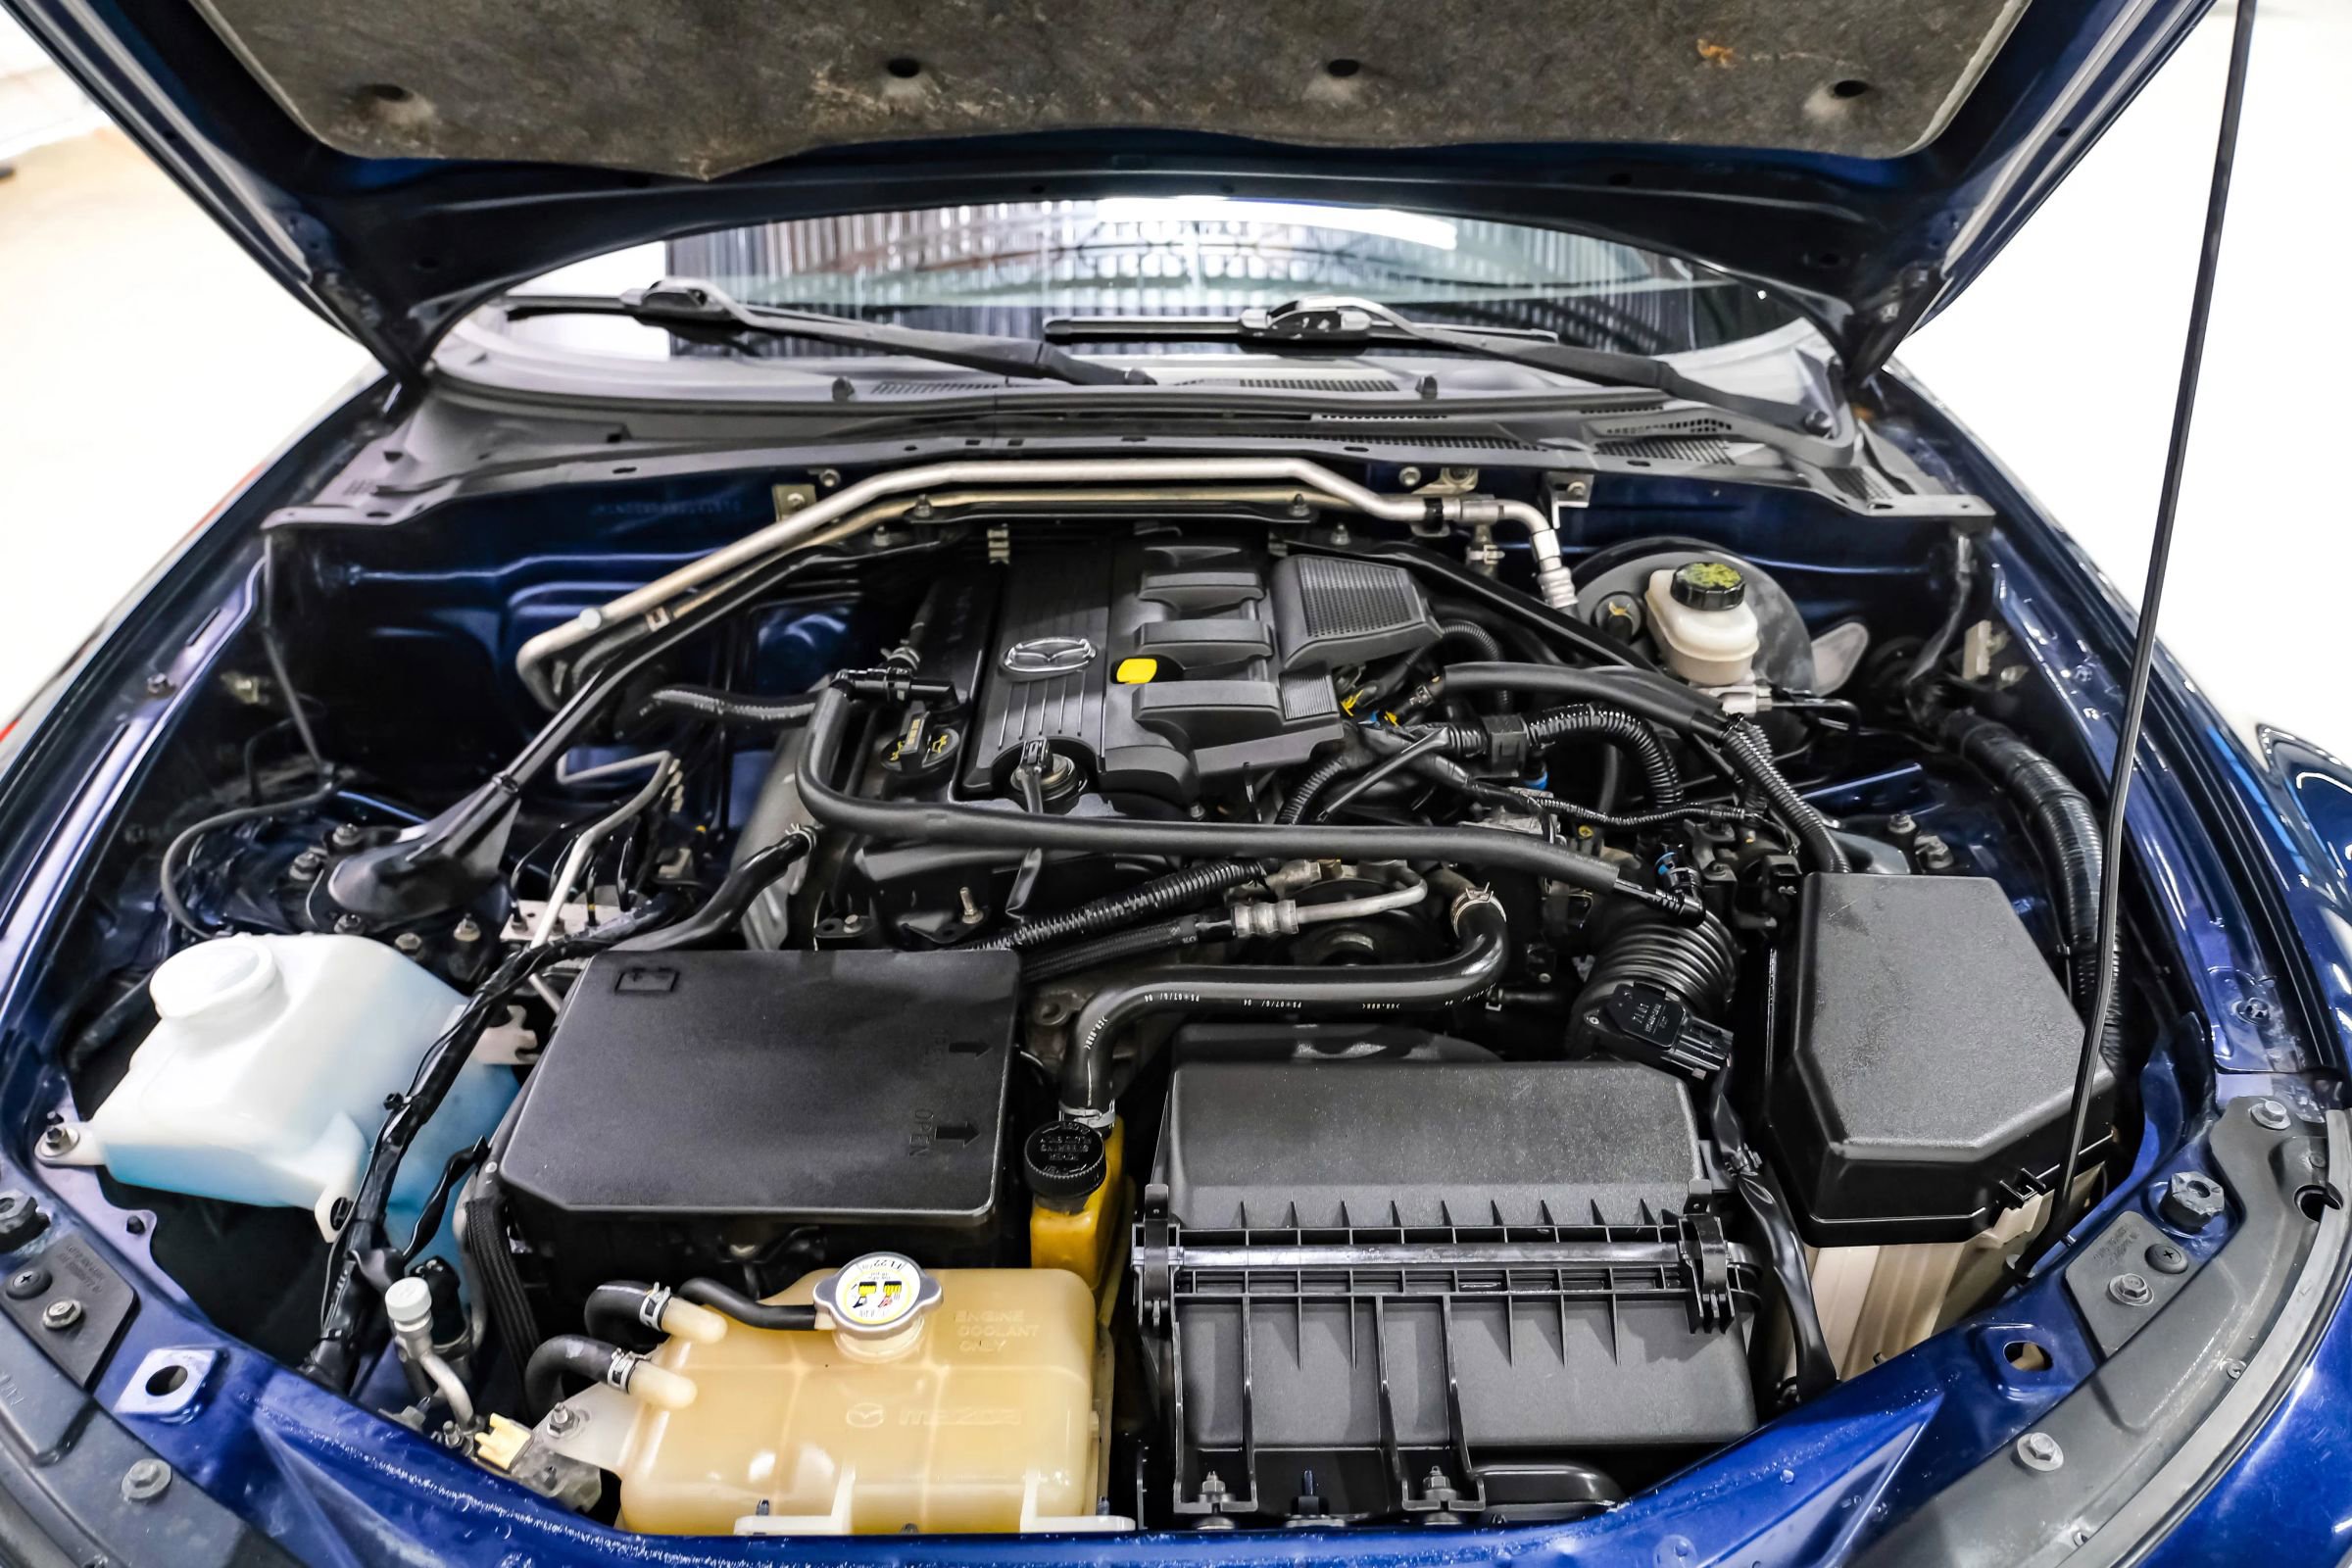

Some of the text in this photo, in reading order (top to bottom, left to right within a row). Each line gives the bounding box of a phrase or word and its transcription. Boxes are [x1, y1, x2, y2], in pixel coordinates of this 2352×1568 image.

[908, 1108, 934, 1156] OPEN
[955, 1309, 1025, 1323] ENGINE
[956, 1324, 1040, 1338] COOLANT
[958, 1340, 1006, 1352] ONLY
